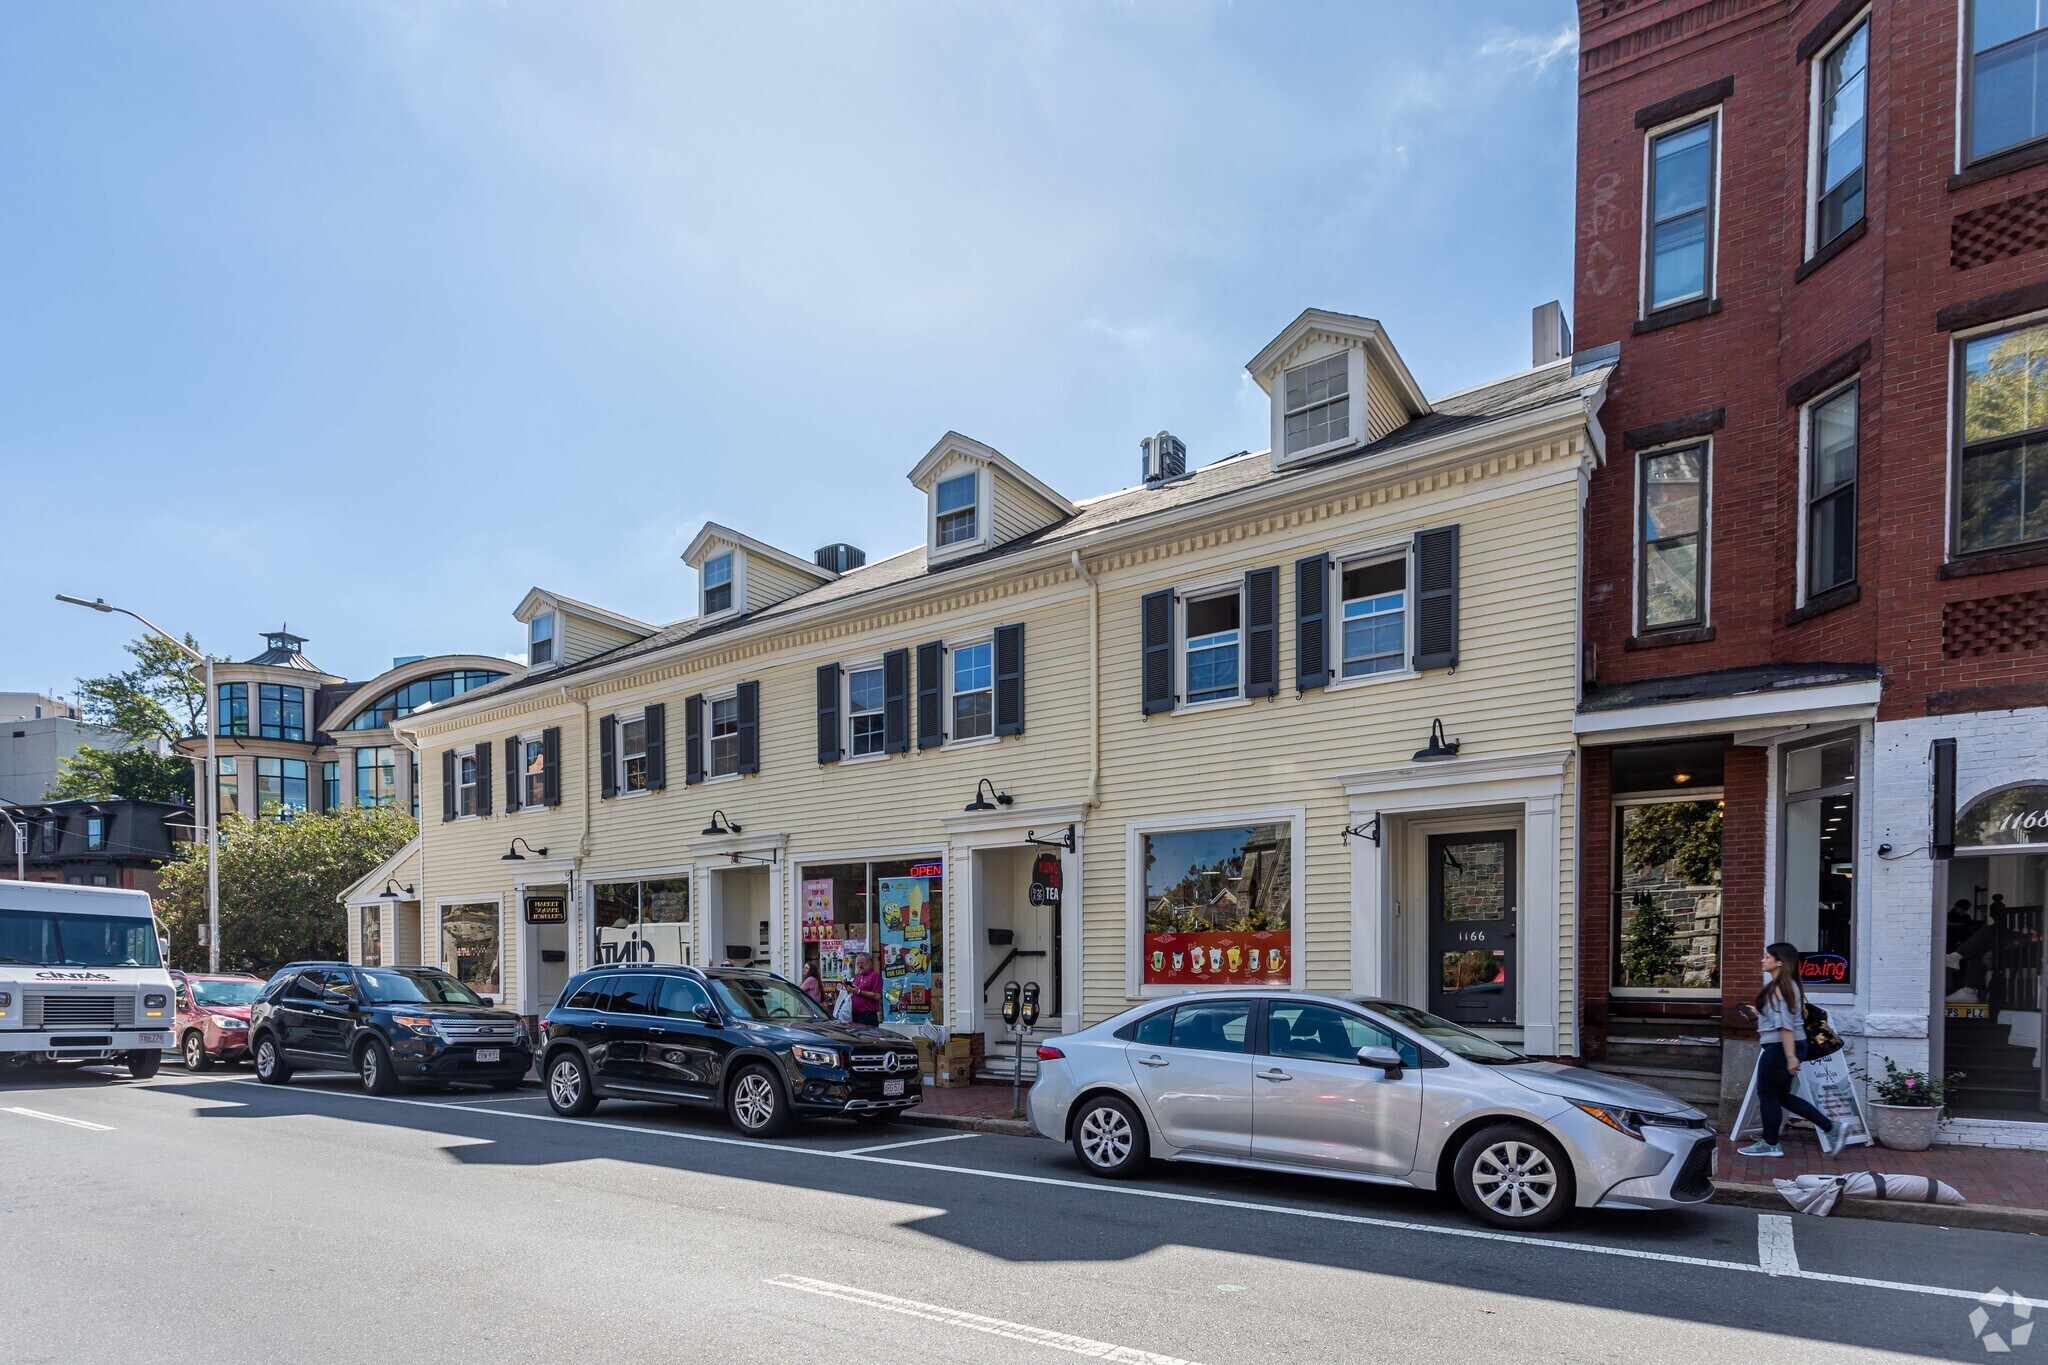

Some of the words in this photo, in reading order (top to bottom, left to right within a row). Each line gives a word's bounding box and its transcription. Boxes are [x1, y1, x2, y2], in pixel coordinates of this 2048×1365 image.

[910, 865, 942, 877] OPEN
[1038, 861, 1059, 873] KUNG
[1045, 887, 1059, 900] TEA
[1459, 931, 1485, 941] 1166
[895, 968, 906, 976] SALE
[1966, 1008, 1983, 1018] PLZ
[1813, 1071, 1826, 1079] Salon
